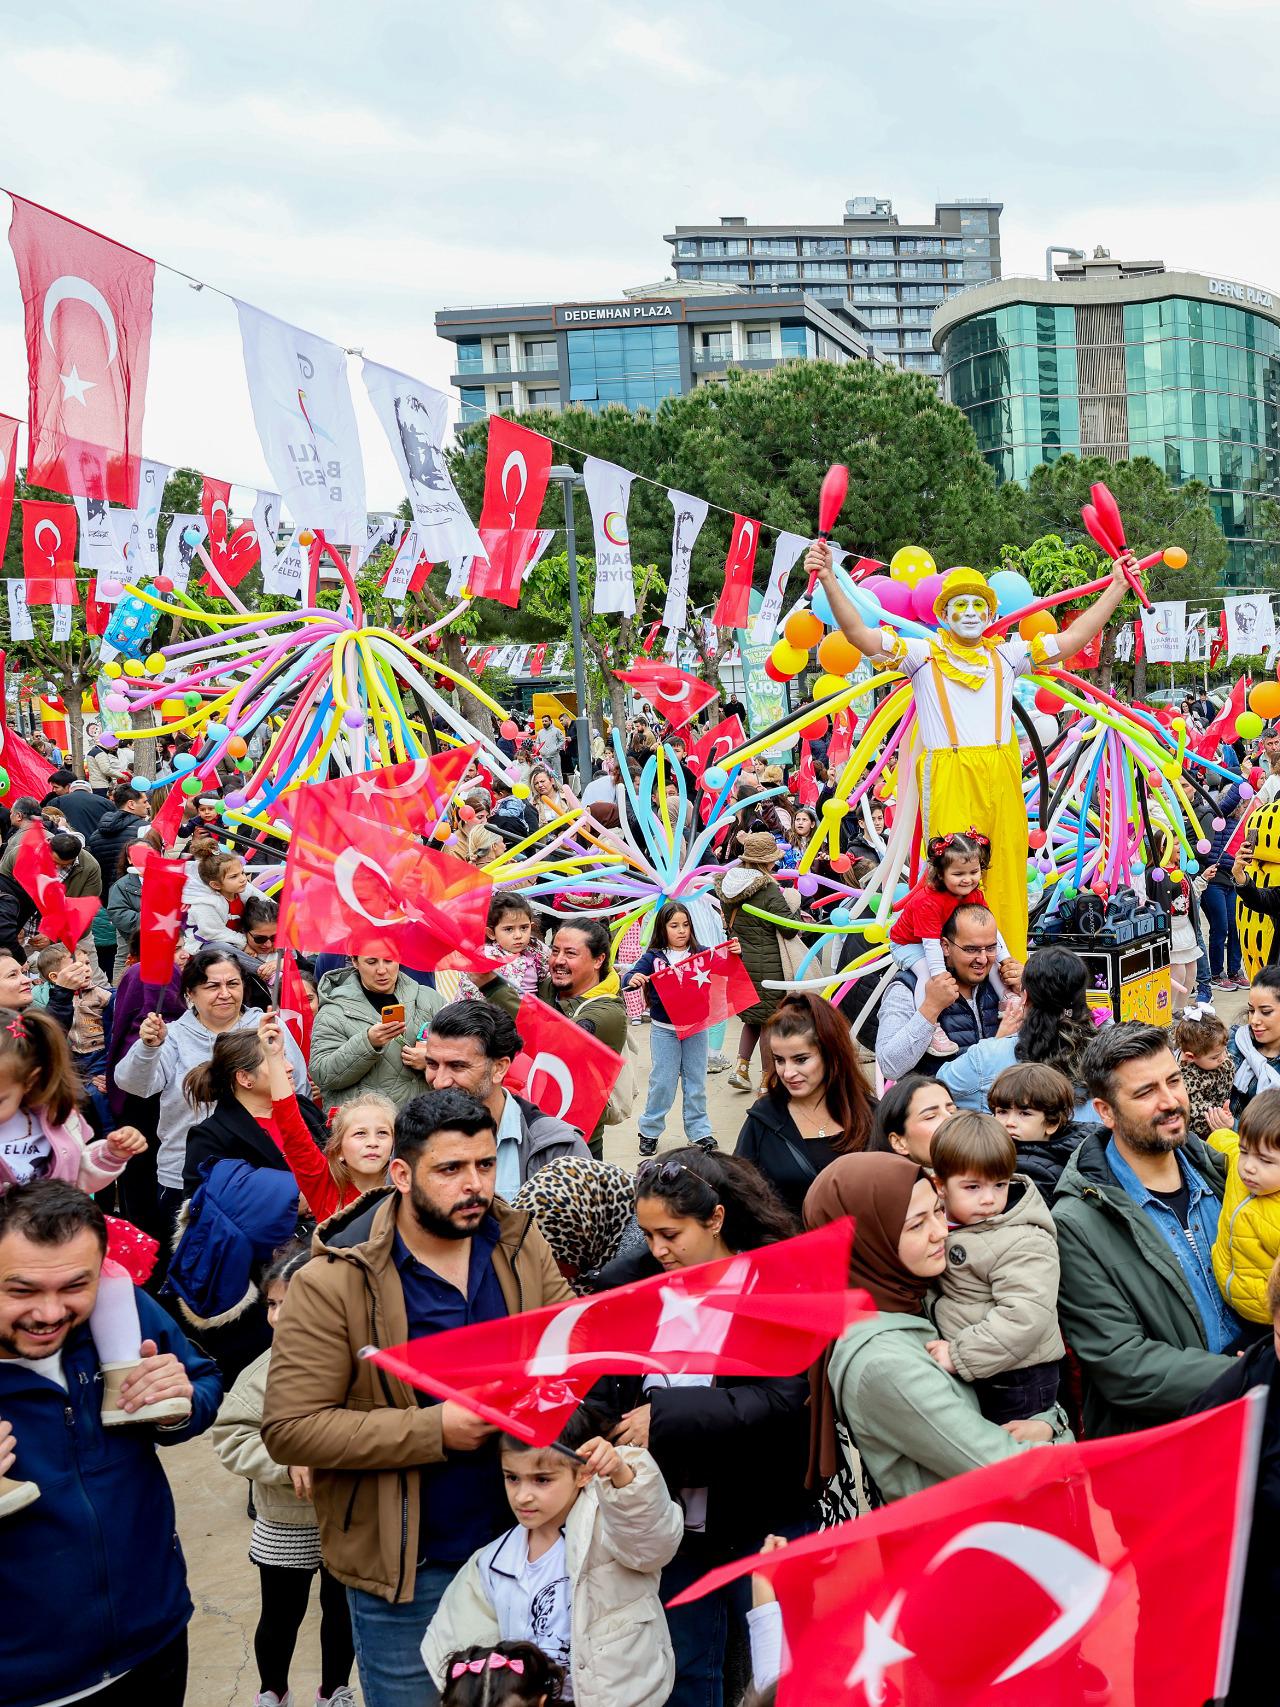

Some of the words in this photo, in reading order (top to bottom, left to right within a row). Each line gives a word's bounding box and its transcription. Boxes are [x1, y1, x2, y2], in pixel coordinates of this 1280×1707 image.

[1208, 279, 1245, 300] DEFNE
[1246, 287, 1273, 309] PLAZA
[564, 307, 630, 321] DEDEMHAN
[633, 305, 672, 317] PLAZA
